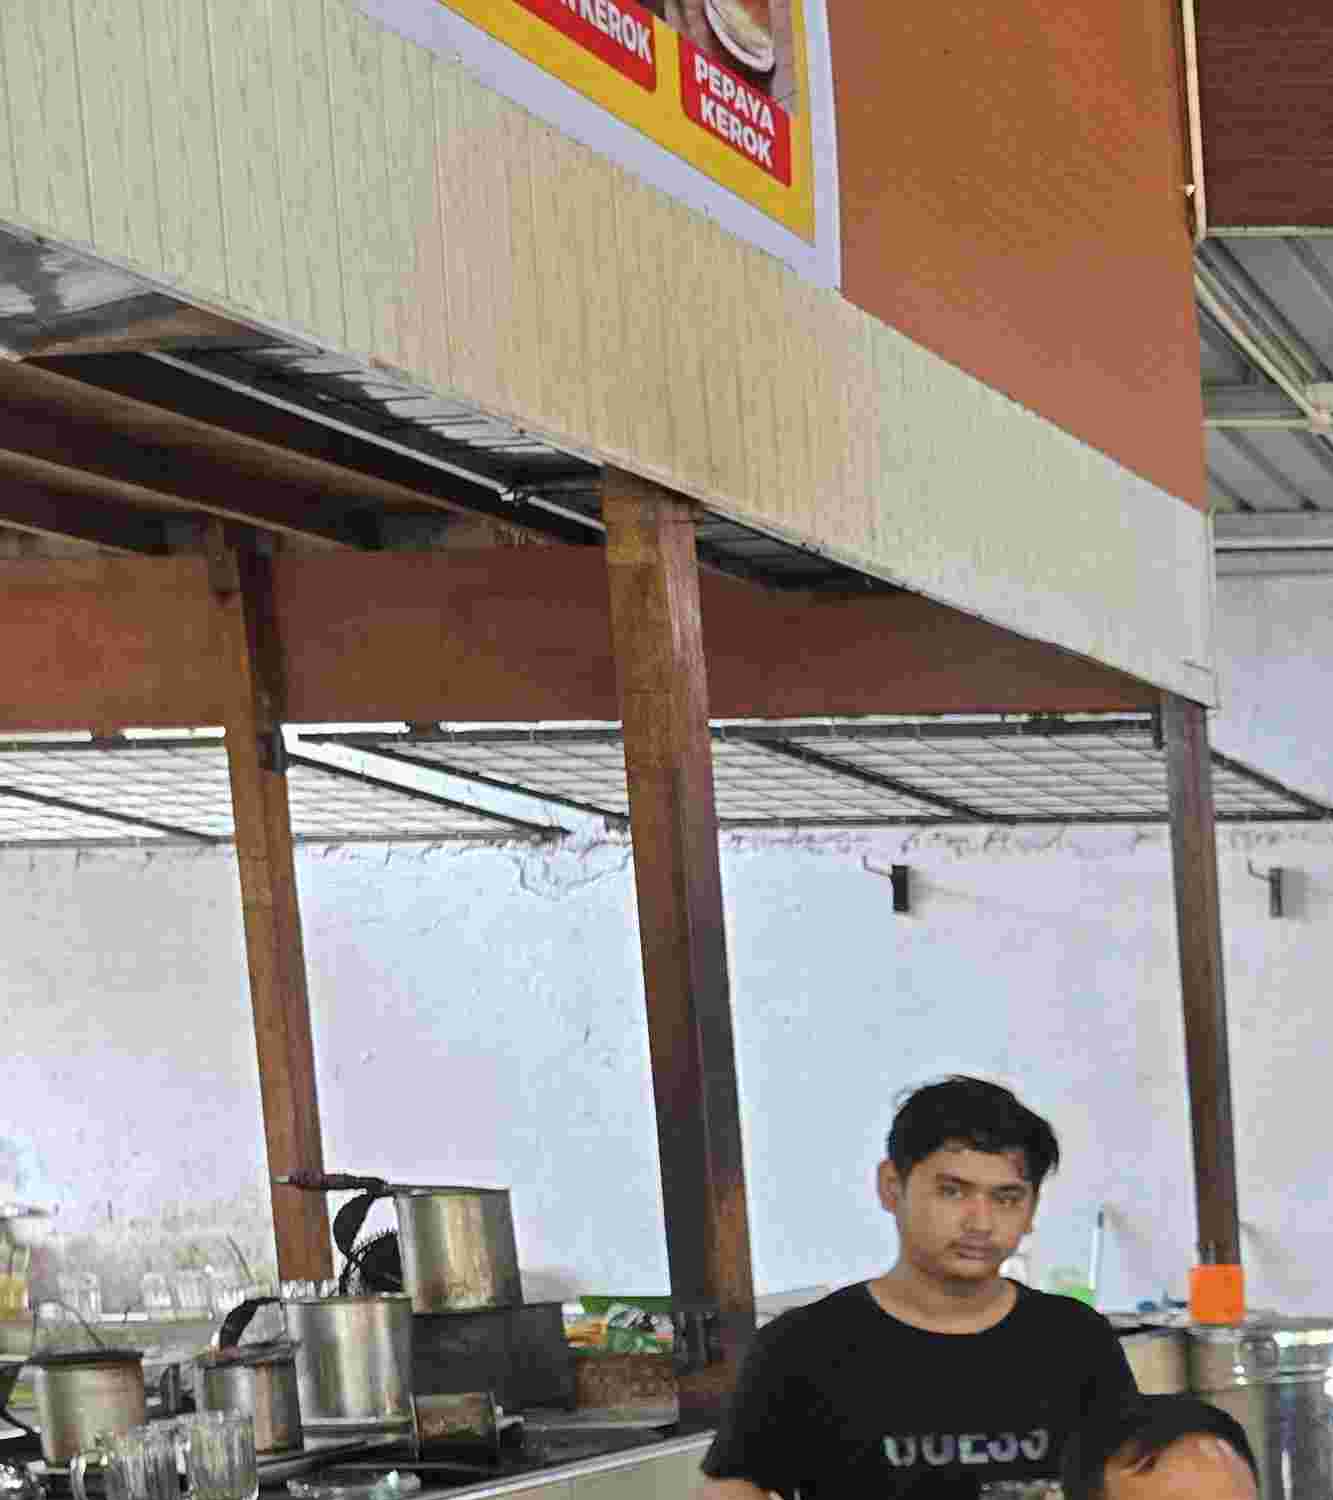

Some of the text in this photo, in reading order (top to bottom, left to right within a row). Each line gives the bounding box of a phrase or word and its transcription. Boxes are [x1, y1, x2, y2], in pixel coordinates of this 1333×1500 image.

[579, 0, 654, 64] KEROK
[695, 54, 776, 137] PEPAYA
[700, 92, 773, 169] KEROK
